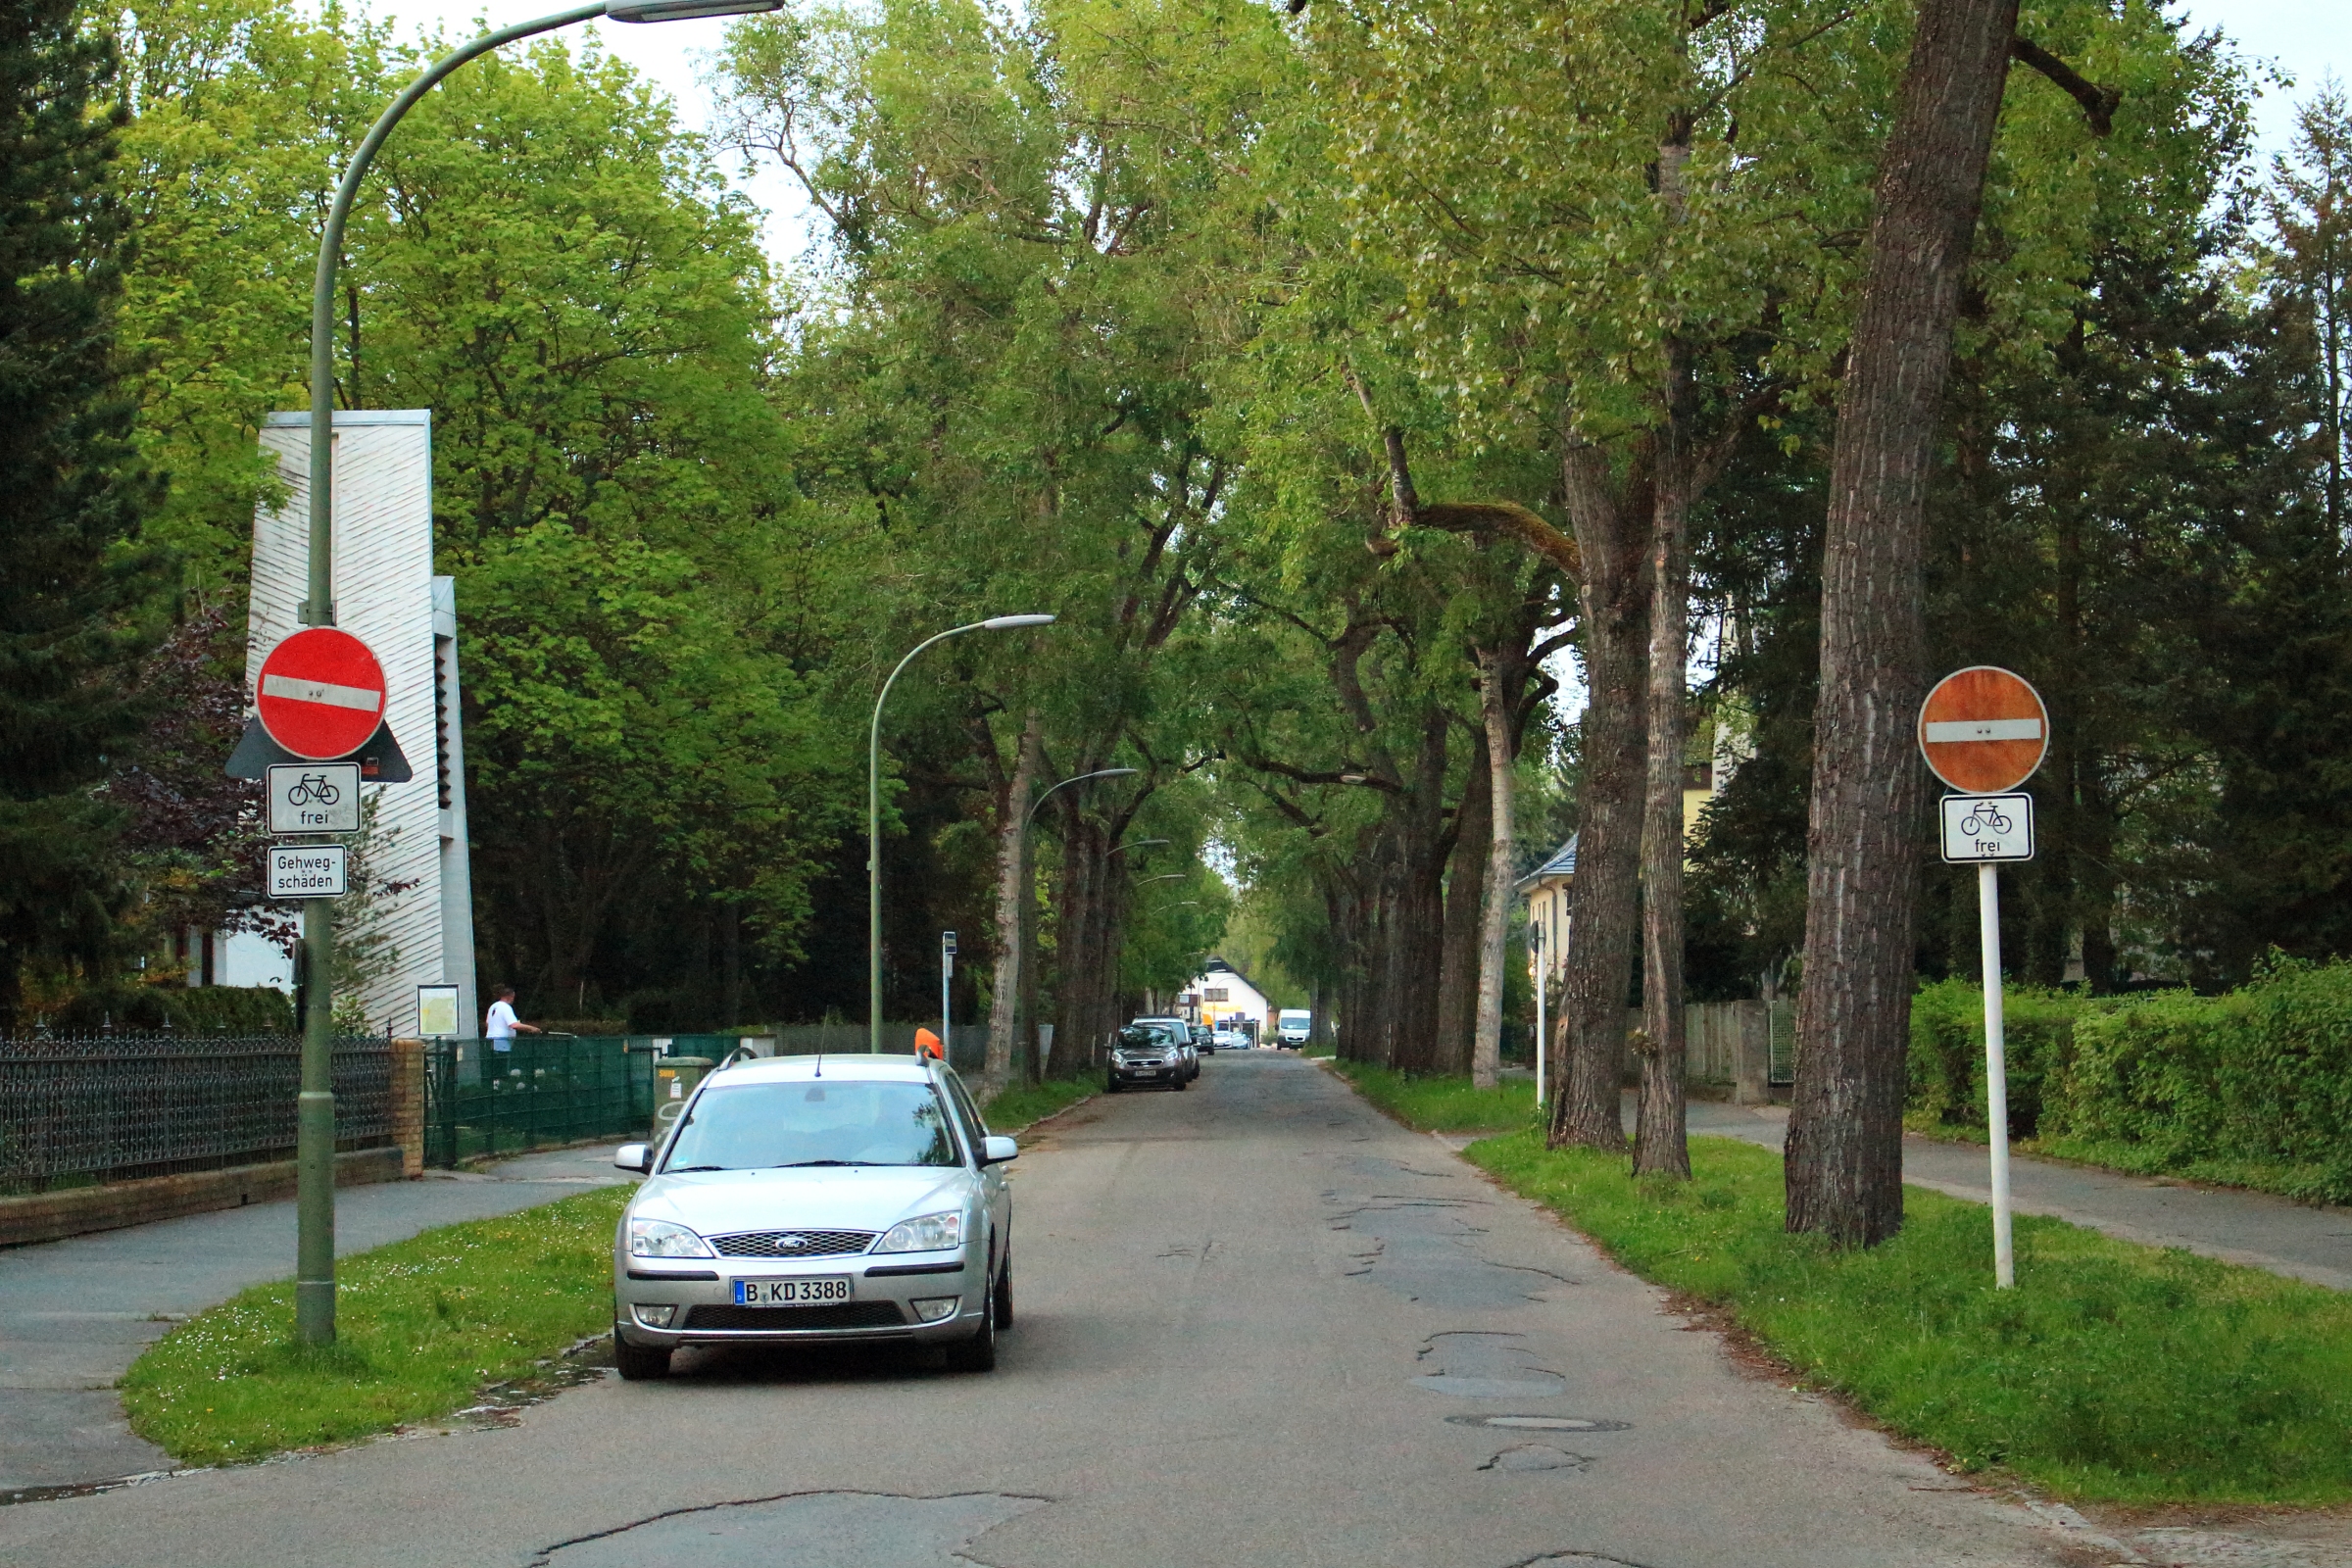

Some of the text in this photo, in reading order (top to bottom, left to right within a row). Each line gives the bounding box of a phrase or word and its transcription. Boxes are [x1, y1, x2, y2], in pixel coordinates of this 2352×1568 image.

[300, 809, 328, 824] frei
[1975, 838, 2000, 853] frei
[277, 856, 336, 871] Gehweg-
[277, 873, 333, 888] schäden
[746, 1284, 759, 1301] B
[770, 1283, 796, 1301] KD
[800, 1281, 847, 1299] 3388
